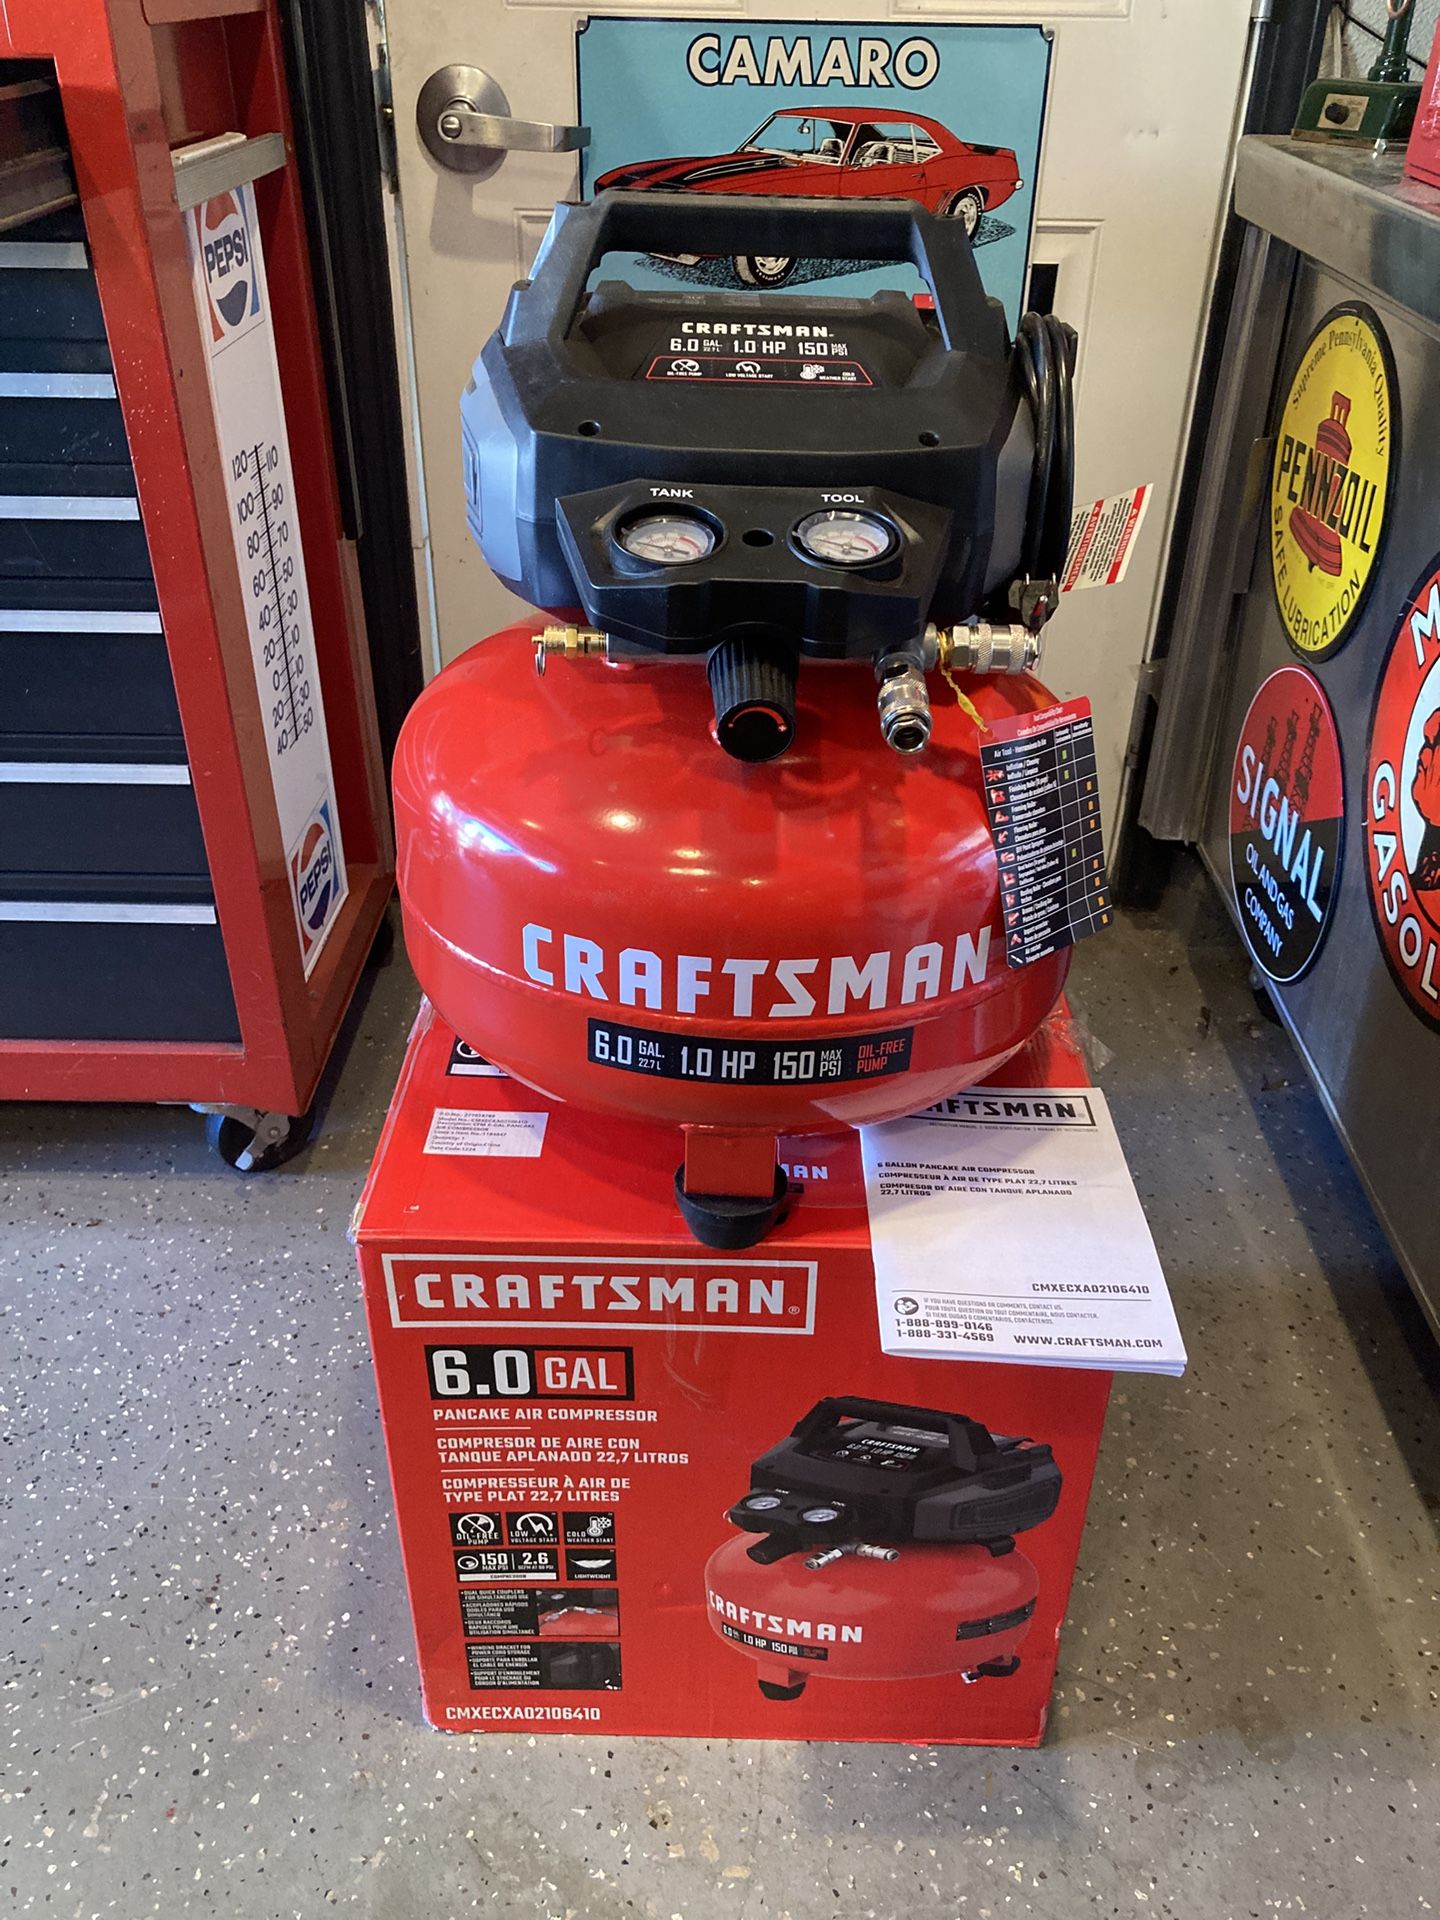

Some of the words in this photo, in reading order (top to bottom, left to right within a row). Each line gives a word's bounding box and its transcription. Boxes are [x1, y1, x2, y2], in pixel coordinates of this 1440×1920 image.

[687, 33, 941, 90] CAMARO
[204, 227, 249, 284] PEPSI
[682, 321, 830, 338] CRAFTSMAN
[670, 338, 699, 351] 6.0
[733, 340, 756, 353] 1.0
[762, 341, 786, 354] HP
[798, 342, 828, 356] 150
[1292, 342, 1327, 411] Supreme
[1328, 329, 1377, 378] Pennsylvania
[1374, 372, 1389, 458] Quality
[231, 449, 248, 482] 120
[265, 444, 279, 473] 110
[271, 483, 284, 511] 90
[650, 487, 693, 498] TANK
[821, 493, 865, 503] TOOL
[1276, 434, 1377, 553] PENNZOIL
[237, 491, 255, 525] 100
[246, 530, 260, 559] 80
[276, 520, 289, 548] 70
[282, 556, 294, 583] 50
[1274, 505, 1288, 588] SAFE
[1282, 568, 1361, 646] LUBRICATION
[252, 569, 266, 598] 60
[286, 589, 298, 616] 30
[258, 604, 271, 631] 40
[263, 638, 276, 668] 20
[272, 669, 280, 692] 0
[272, 699, 284, 729] 20
[276, 728, 288, 756] 40
[1236, 743, 1325, 924] SIGNAL
[300, 839, 332, 915] PEPSI
[1245, 842, 1259, 877] OIL
[1257, 863, 1279, 902] AND
[1275, 890, 1295, 931] GAS
[1244, 886, 1284, 958] COMPANY
[522, 922, 992, 1017] CRAFTSMAN
[595, 1029, 632, 1065] 6.0
[639, 1039, 665, 1058] GAL.
[681, 1046, 713, 1077] 1.0
[721, 1050, 756, 1079] HP
[773, 1051, 815, 1080] 150
[821, 1048, 842, 1061] MAX
[858, 1038, 905, 1058] OIL-FREE
[857, 1056, 888, 1073] PUMP
[819, 1060, 842, 1077] PSI
[926, 1098, 1076, 1118] FTSMAN
[878, 1172, 941, 1181] COMPRESSEUR
[919, 1163, 959, 1171] PANCAKE
[978, 1167, 1035, 1175] COMPRESSOR
[880, 1183, 932, 1191] COMPRESOR
[413, 1273, 785, 1315] CRAFTSMAN
[1032, 1283, 1150, 1295] CMXECXA02106410
[896, 1318, 993, 1331] 1-888-899-0146
[896, 1329, 994, 1341] 1-888-331-4569
[1013, 1334, 1163, 1348] WWW.CRAFTSMAN.COM
[431, 1349, 531, 1397] 6.0
[544, 1356, 618, 1391] GAL
[433, 1408, 511, 1421] PANCAKE
[514, 1408, 543, 1420] AIR
[547, 1408, 658, 1422] COMPRESSOR
[436, 1437, 537, 1450] COMPRESOR
[540, 1437, 561, 1449] DE
[566, 1437, 603, 1449] AIRE
[607, 1437, 640, 1449] CON
[438, 1451, 502, 1464] TANQUE
[506, 1451, 592, 1463] APLANADO
[596, 1451, 629, 1465] 22,7
[634, 1452, 689, 1464] LITROS
[442, 1477, 559, 1489] COMPRESSEUR
[563, 1475, 575, 1488] À
[578, 1477, 606, 1489] AIR
[610, 1477, 631, 1488] DE
[443, 1491, 483, 1503] TYPE
[487, 1491, 526, 1502] PLAT
[530, 1491, 563, 1504] 22,7
[567, 1491, 620, 1502] LITRES
[456, 1532, 499, 1540] OIL-FREE
[479, 1553, 508, 1565] 150
[522, 1552, 549, 1565] 2.6
[708, 1590, 863, 1643] CRAFTSMAN
[755, 1637, 766, 1648] HP
[771, 1641, 787, 1654] 150
[446, 1706, 601, 1721] CMXECXA02106410
